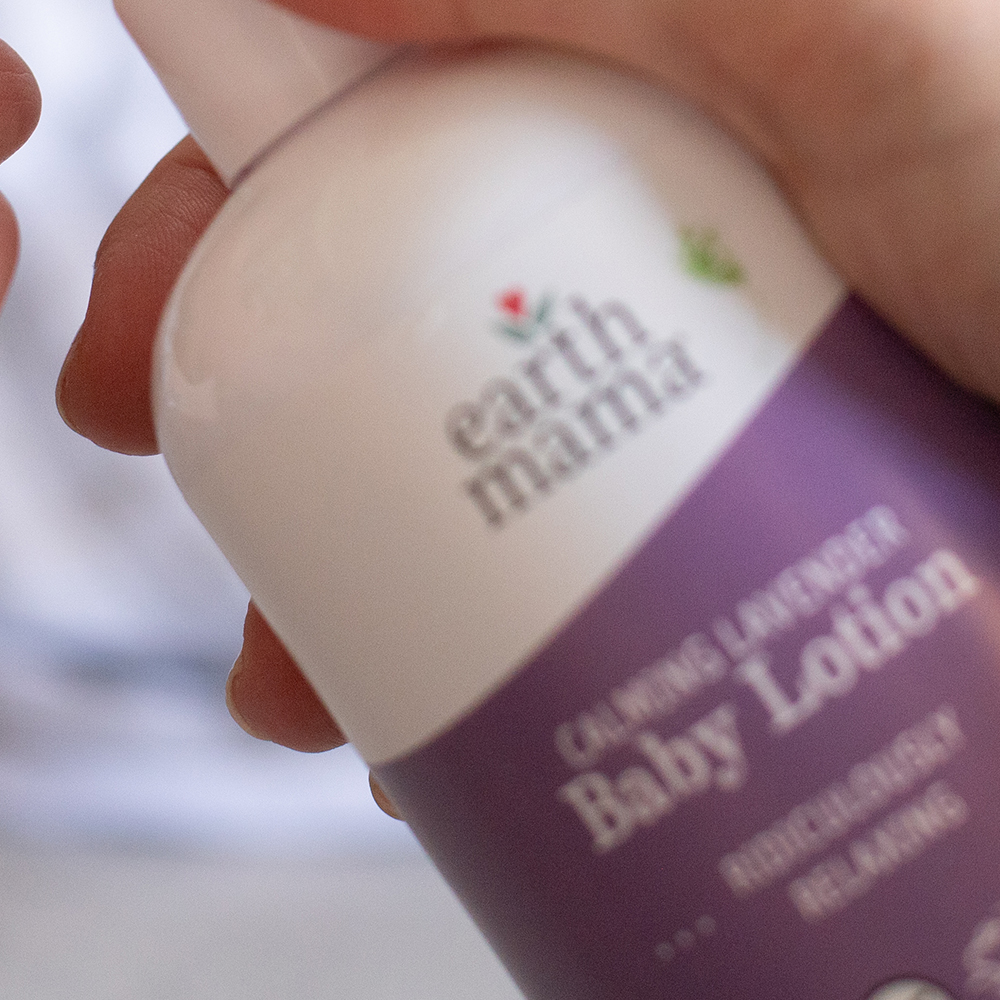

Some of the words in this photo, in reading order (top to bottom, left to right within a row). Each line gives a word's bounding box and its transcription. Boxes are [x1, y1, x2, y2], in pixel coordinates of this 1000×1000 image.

[443, 294, 650, 462] earth
[461, 337, 706, 530] mama
[554, 630, 728, 768] CALMING
[712, 504, 908, 662] LAVENDER
[557, 702, 747, 853] Baby
[734, 548, 977, 734] Lotion
[790, 780, 968, 920] RELAXING
